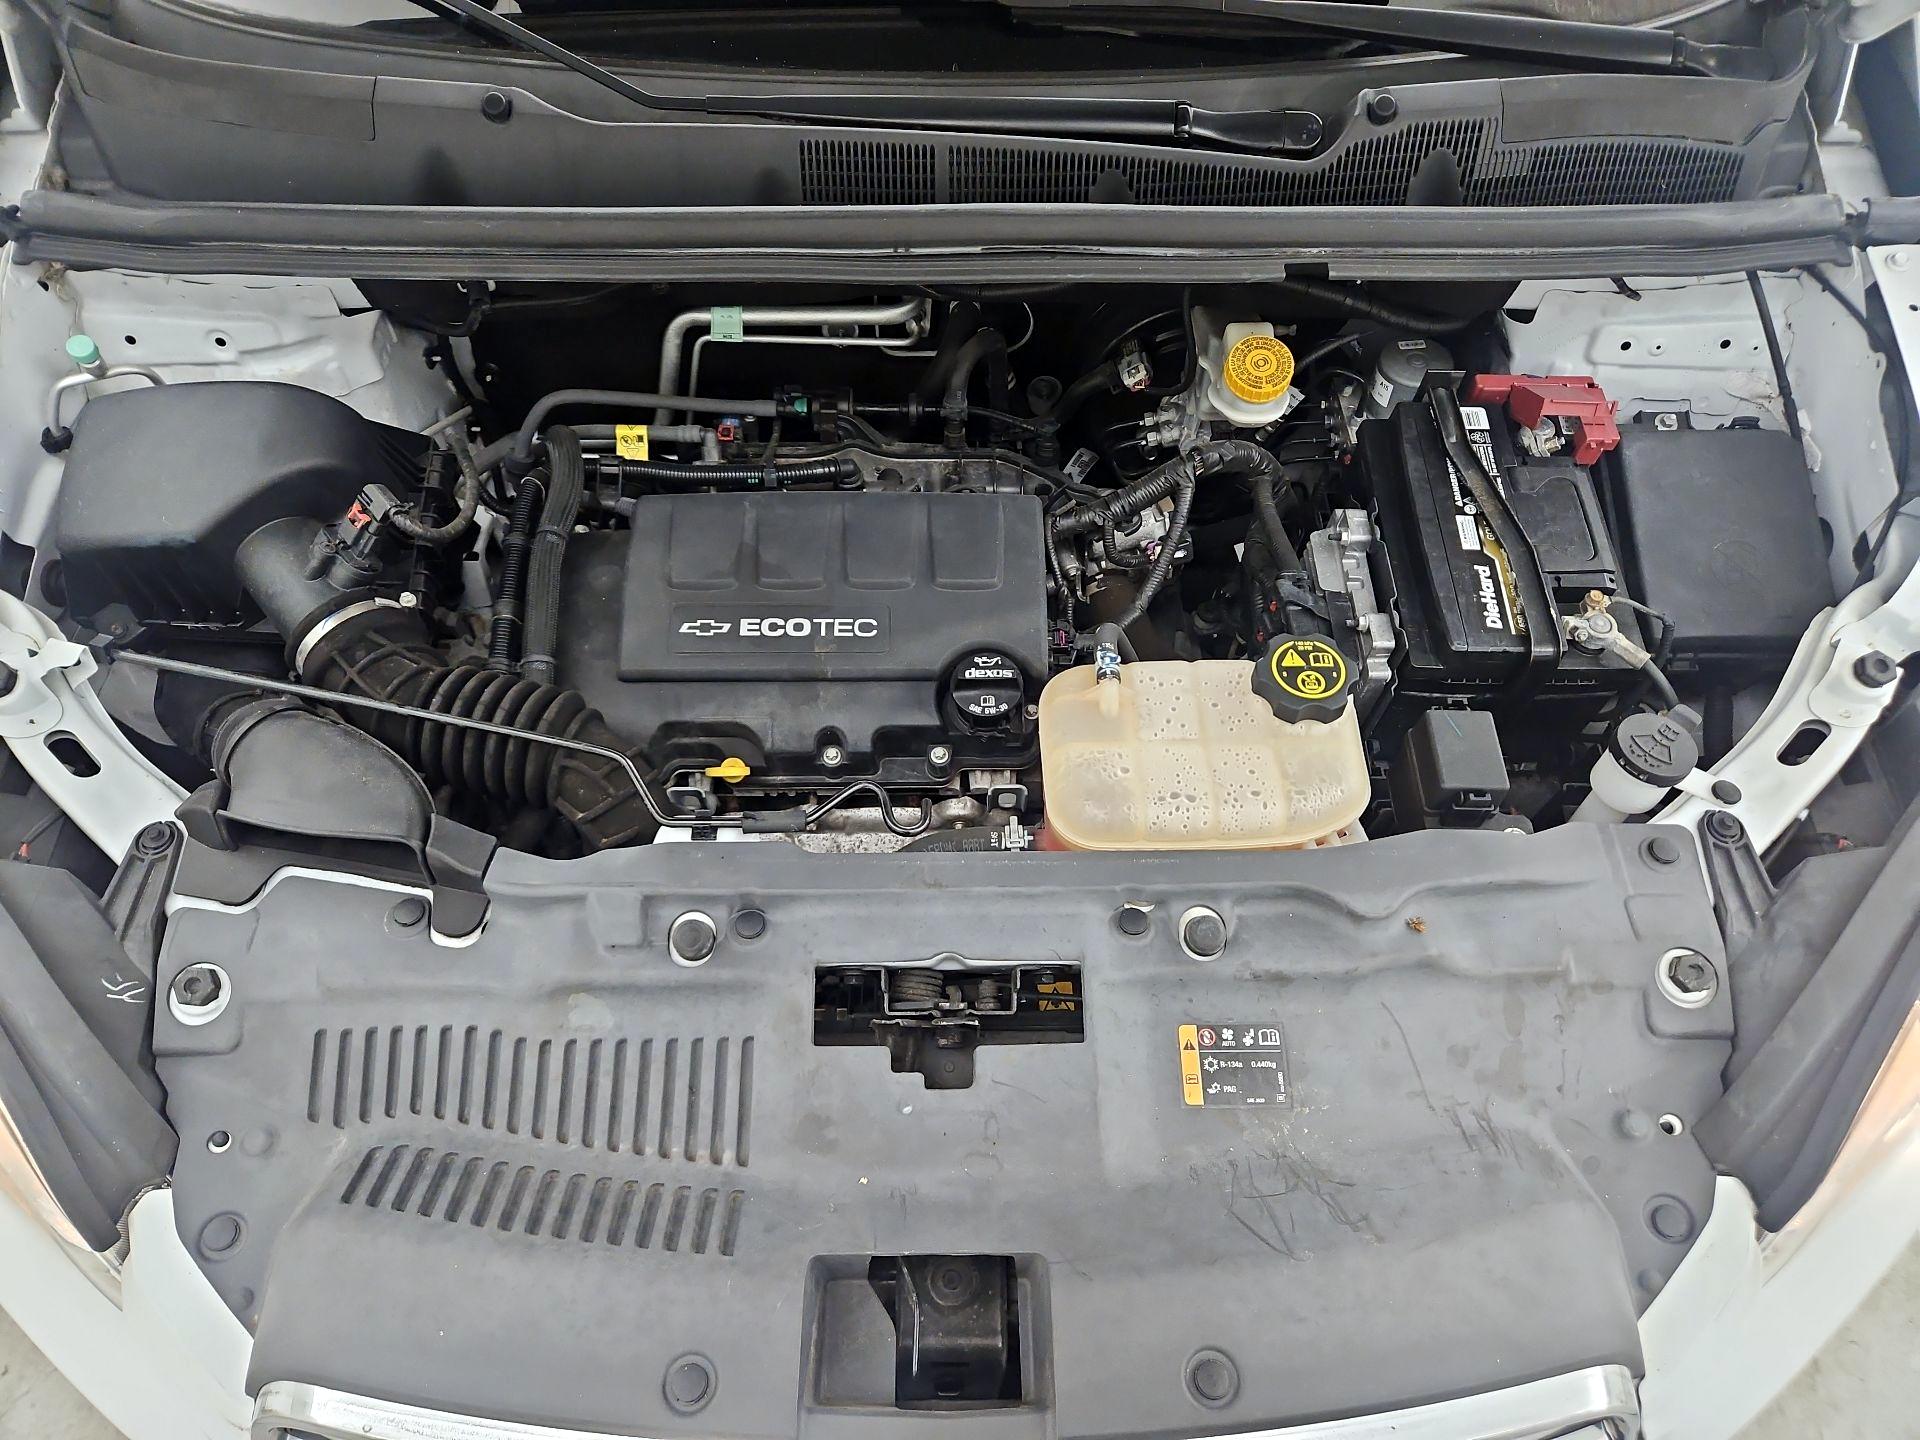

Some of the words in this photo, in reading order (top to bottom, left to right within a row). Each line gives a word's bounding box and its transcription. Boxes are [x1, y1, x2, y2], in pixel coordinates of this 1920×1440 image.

[1474, 564, 1503, 630] DieHard
[739, 618, 878, 637] ECOTEC
[964, 667, 1015, 678] dexos
[968, 703, 983, 714] SAE
[1220, 1060, 1243, 1068] R-134a
[1223, 1085, 1237, 1093] PAG
